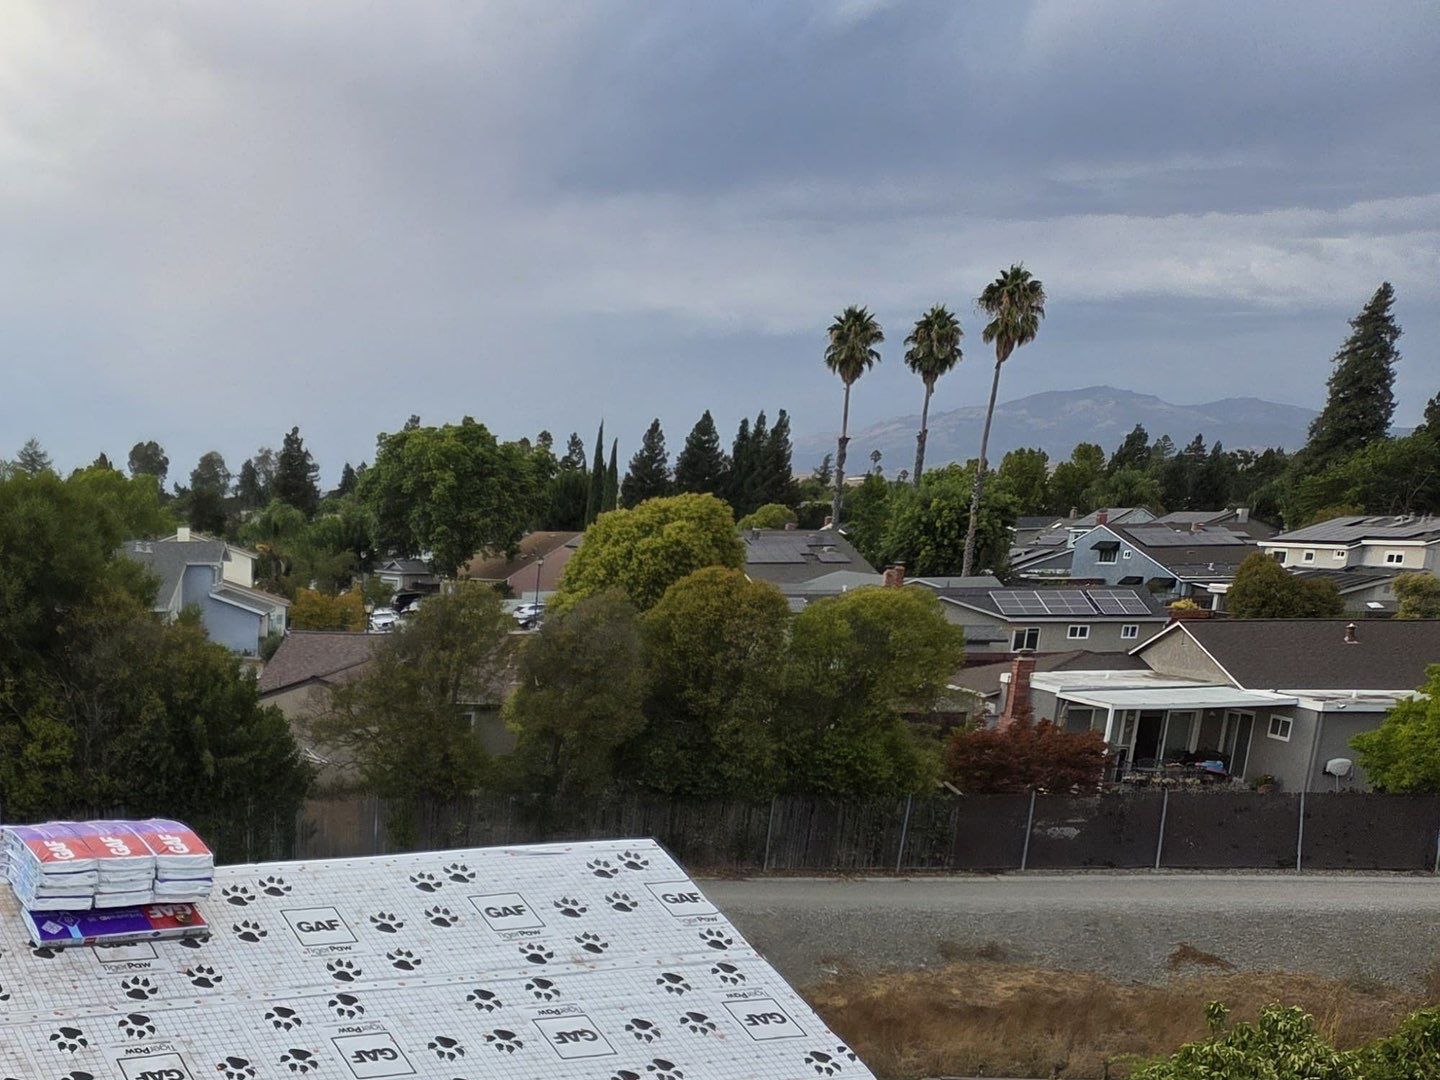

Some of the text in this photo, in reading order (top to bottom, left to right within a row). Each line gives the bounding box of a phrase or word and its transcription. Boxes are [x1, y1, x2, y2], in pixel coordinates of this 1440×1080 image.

[44, 840, 75, 860] GAF
[99, 835, 132, 856] GAF
[158, 834, 190, 854] GAF
[662, 892, 702, 904] GAF
[485, 905, 526, 918] GAF
[297, 919, 340, 933] GAF
[744, 1012, 787, 1026] GAF
[554, 1029, 599, 1044] GAF
[351, 1048, 399, 1064] GAF
